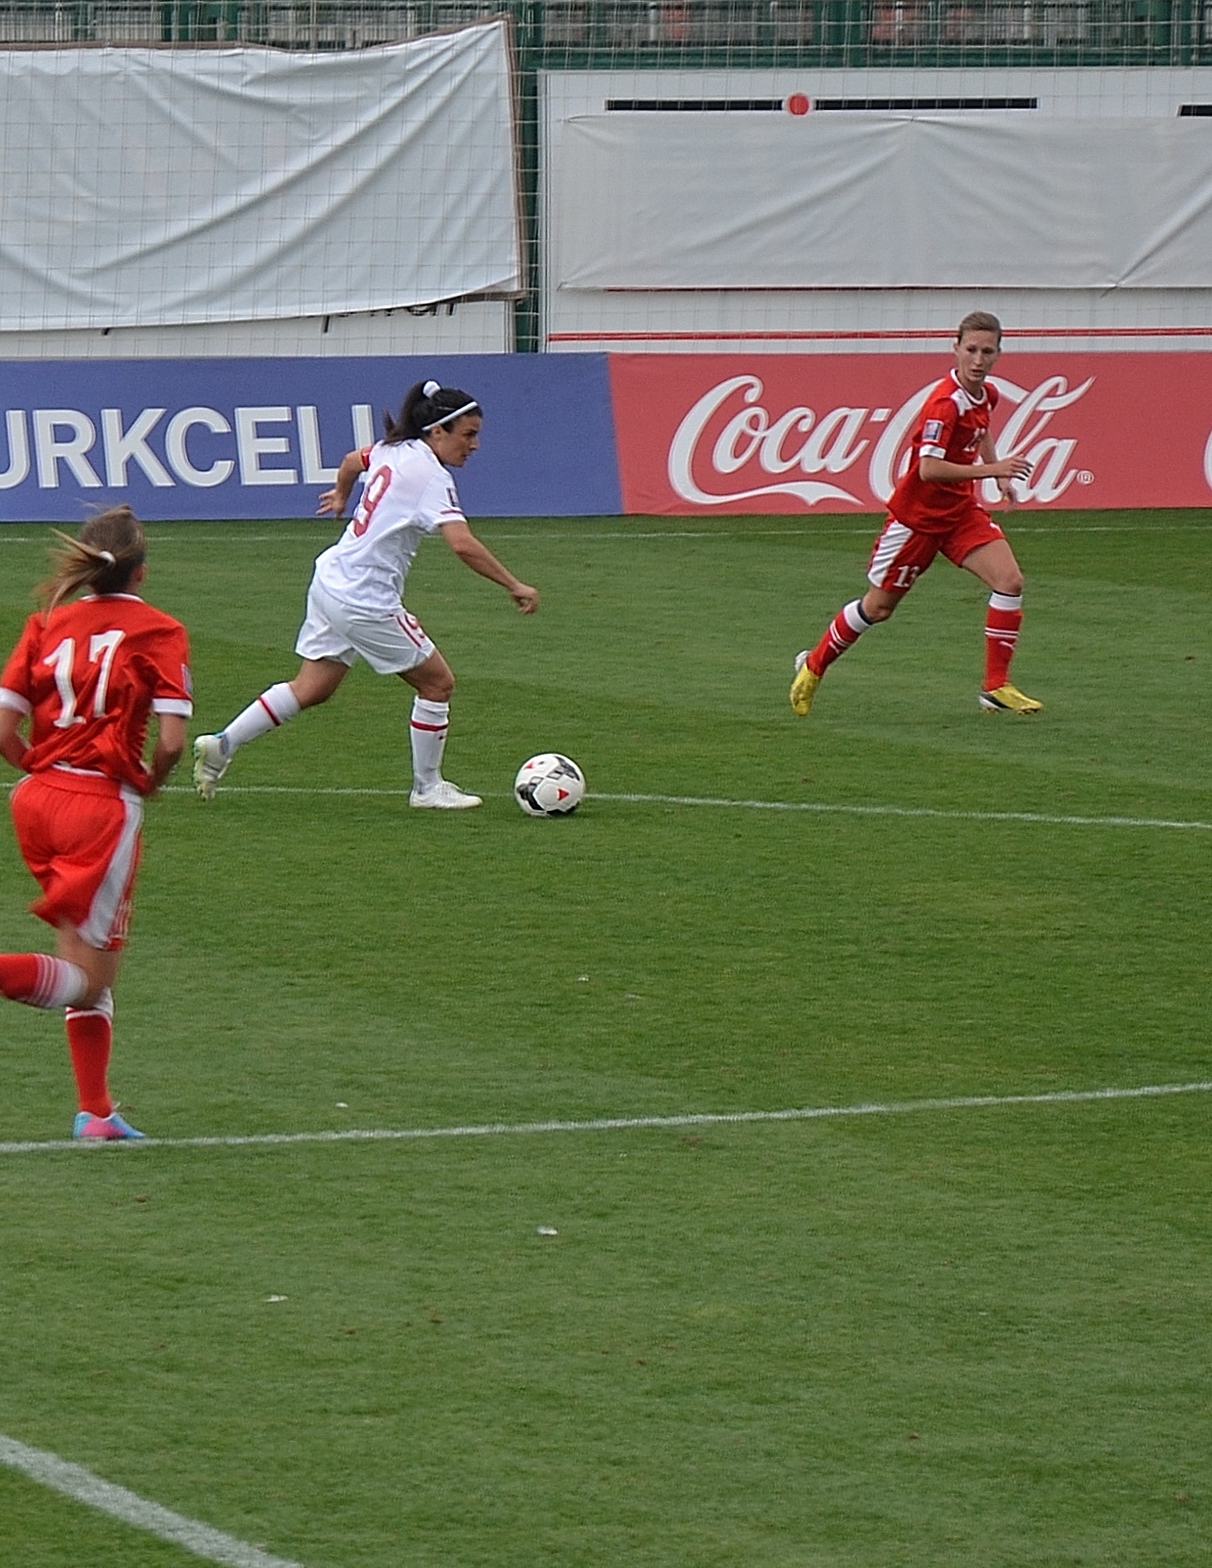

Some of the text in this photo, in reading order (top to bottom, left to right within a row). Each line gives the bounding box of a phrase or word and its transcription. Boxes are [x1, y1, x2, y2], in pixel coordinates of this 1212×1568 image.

[667, 373, 1096, 507] Coca-Cla
[353, 464, 392, 538] 9
[43, 629, 126, 730] 17
